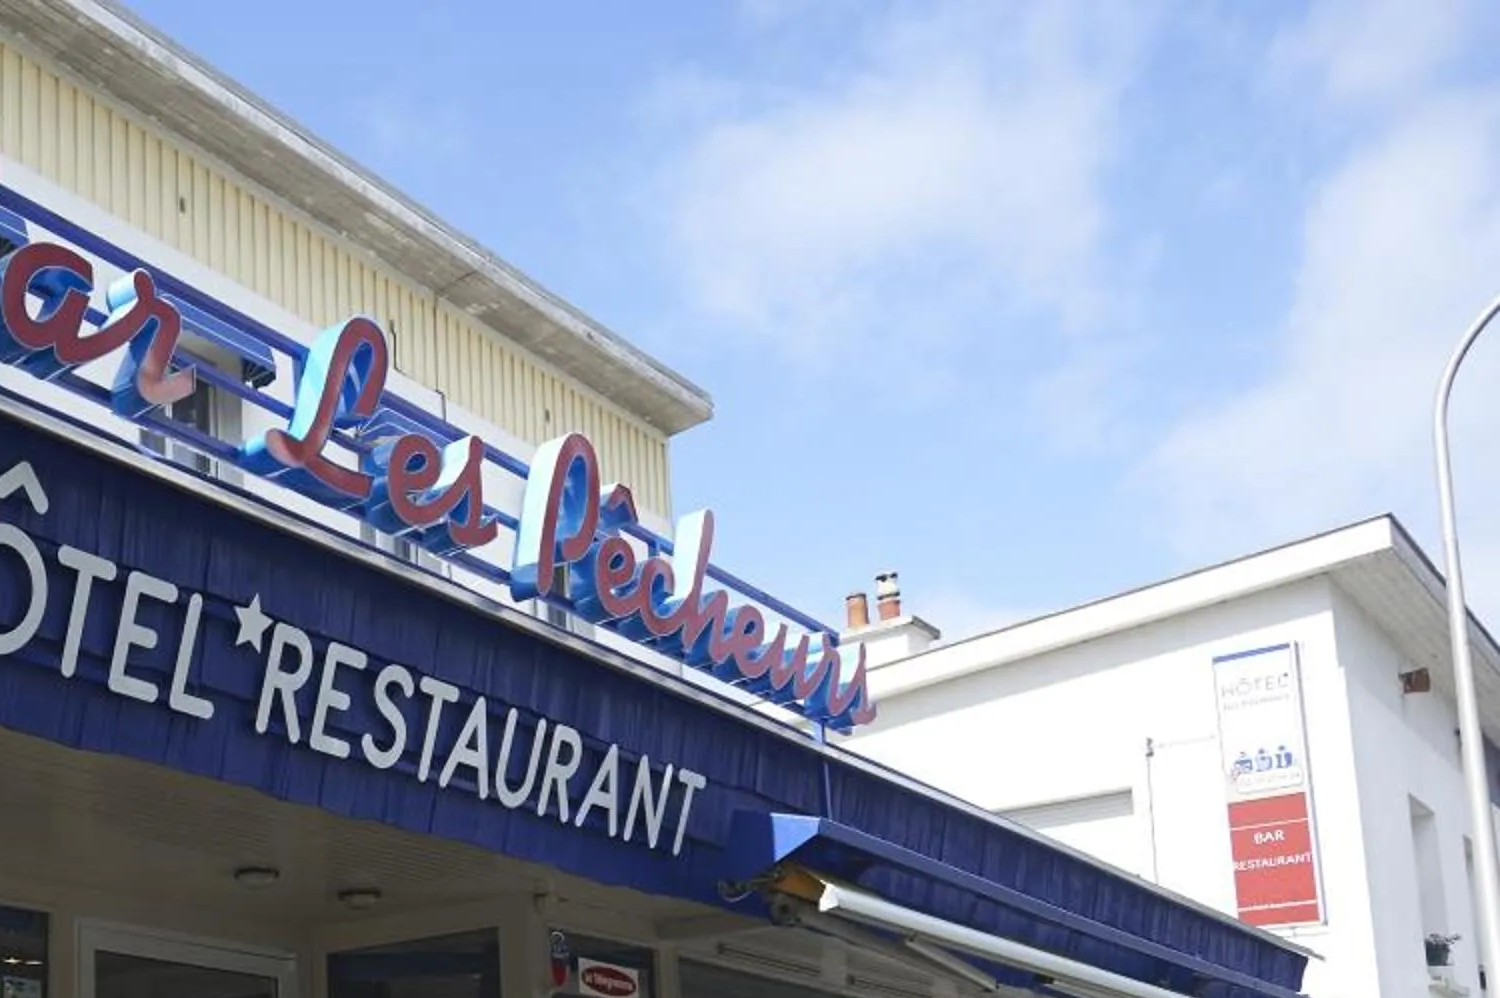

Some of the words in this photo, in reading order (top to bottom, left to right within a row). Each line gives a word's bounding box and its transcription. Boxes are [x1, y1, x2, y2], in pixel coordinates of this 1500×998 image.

[258, 315, 498, 549] Les
[532, 432, 878, 728] Pêcheurs
[255, 620, 707, 857] RESTAURANT
[1234, 852, 1312, 871] RESTAURANT
[1253, 830, 1285, 845] BAR
